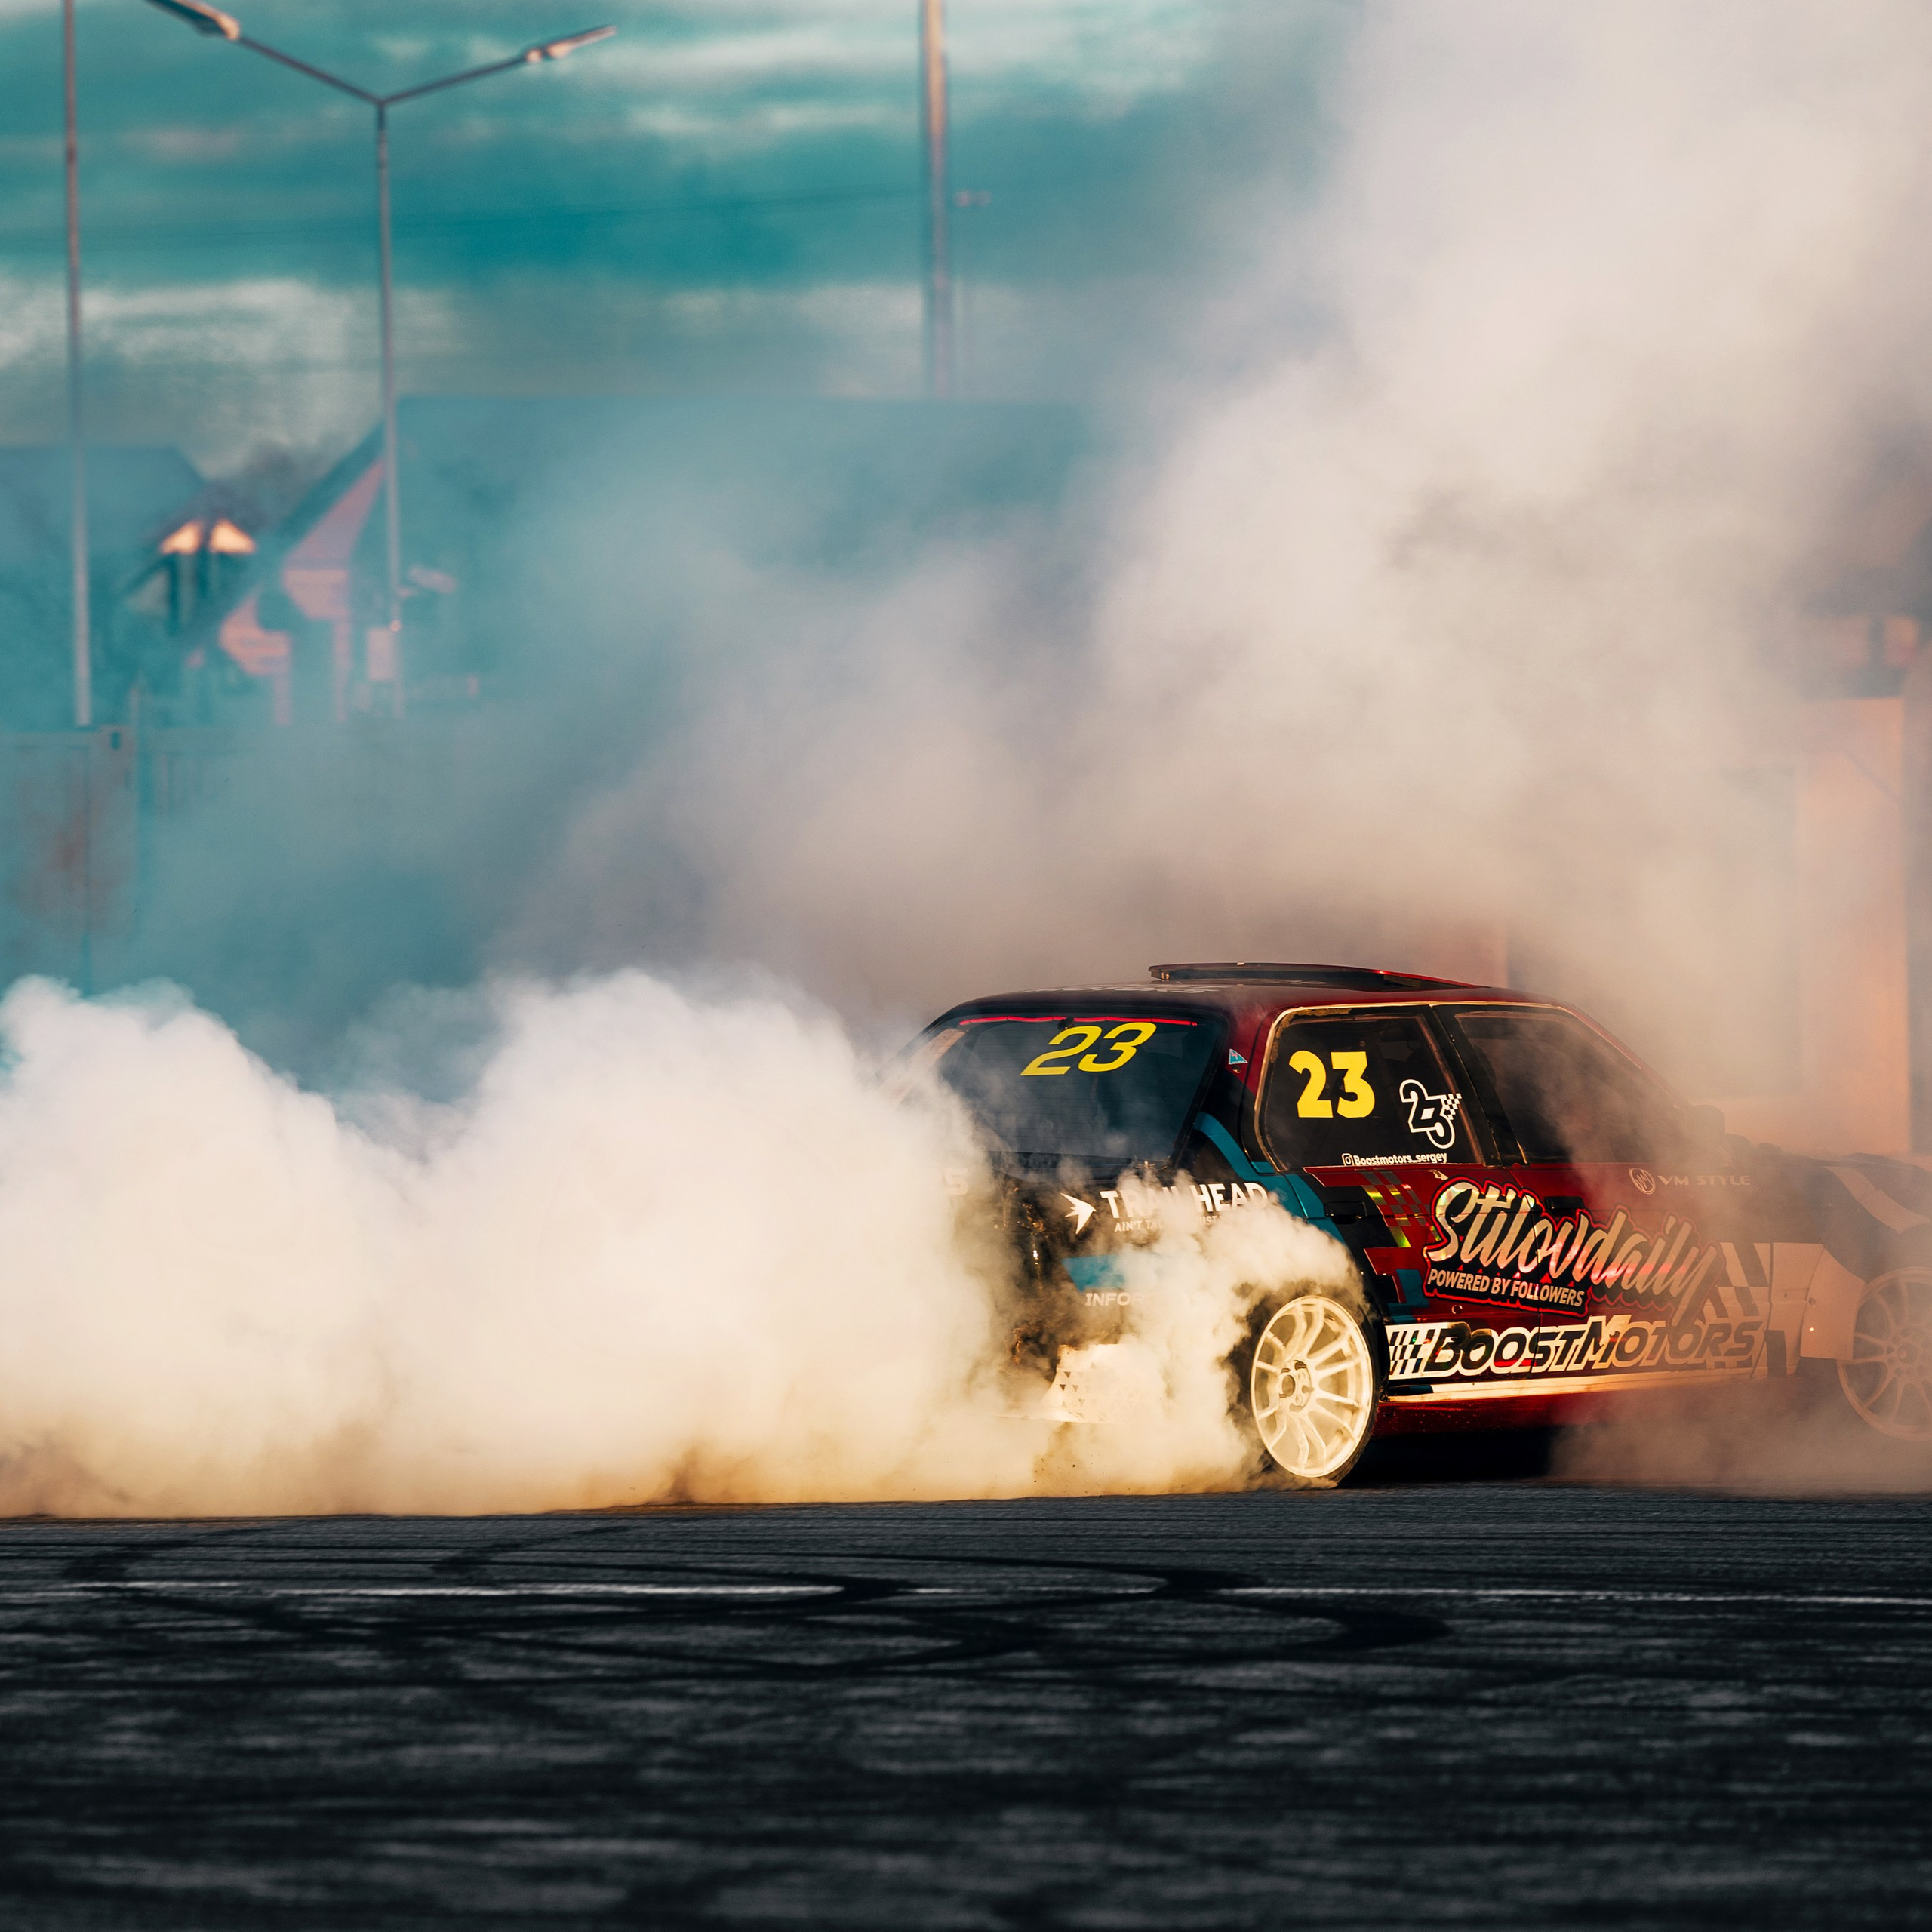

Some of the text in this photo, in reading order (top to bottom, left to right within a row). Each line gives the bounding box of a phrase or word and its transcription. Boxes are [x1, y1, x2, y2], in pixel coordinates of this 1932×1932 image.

[1020, 1023, 1156, 1076] 23
[1289, 1050, 1375, 1118] 23
[1353, 1152, 1447, 1167] Boostmotors_sergey
[1657, 1175, 1751, 1186] VM STYLE
[1427, 1269, 1585, 1307] POWERED BY FOLLOWERS
